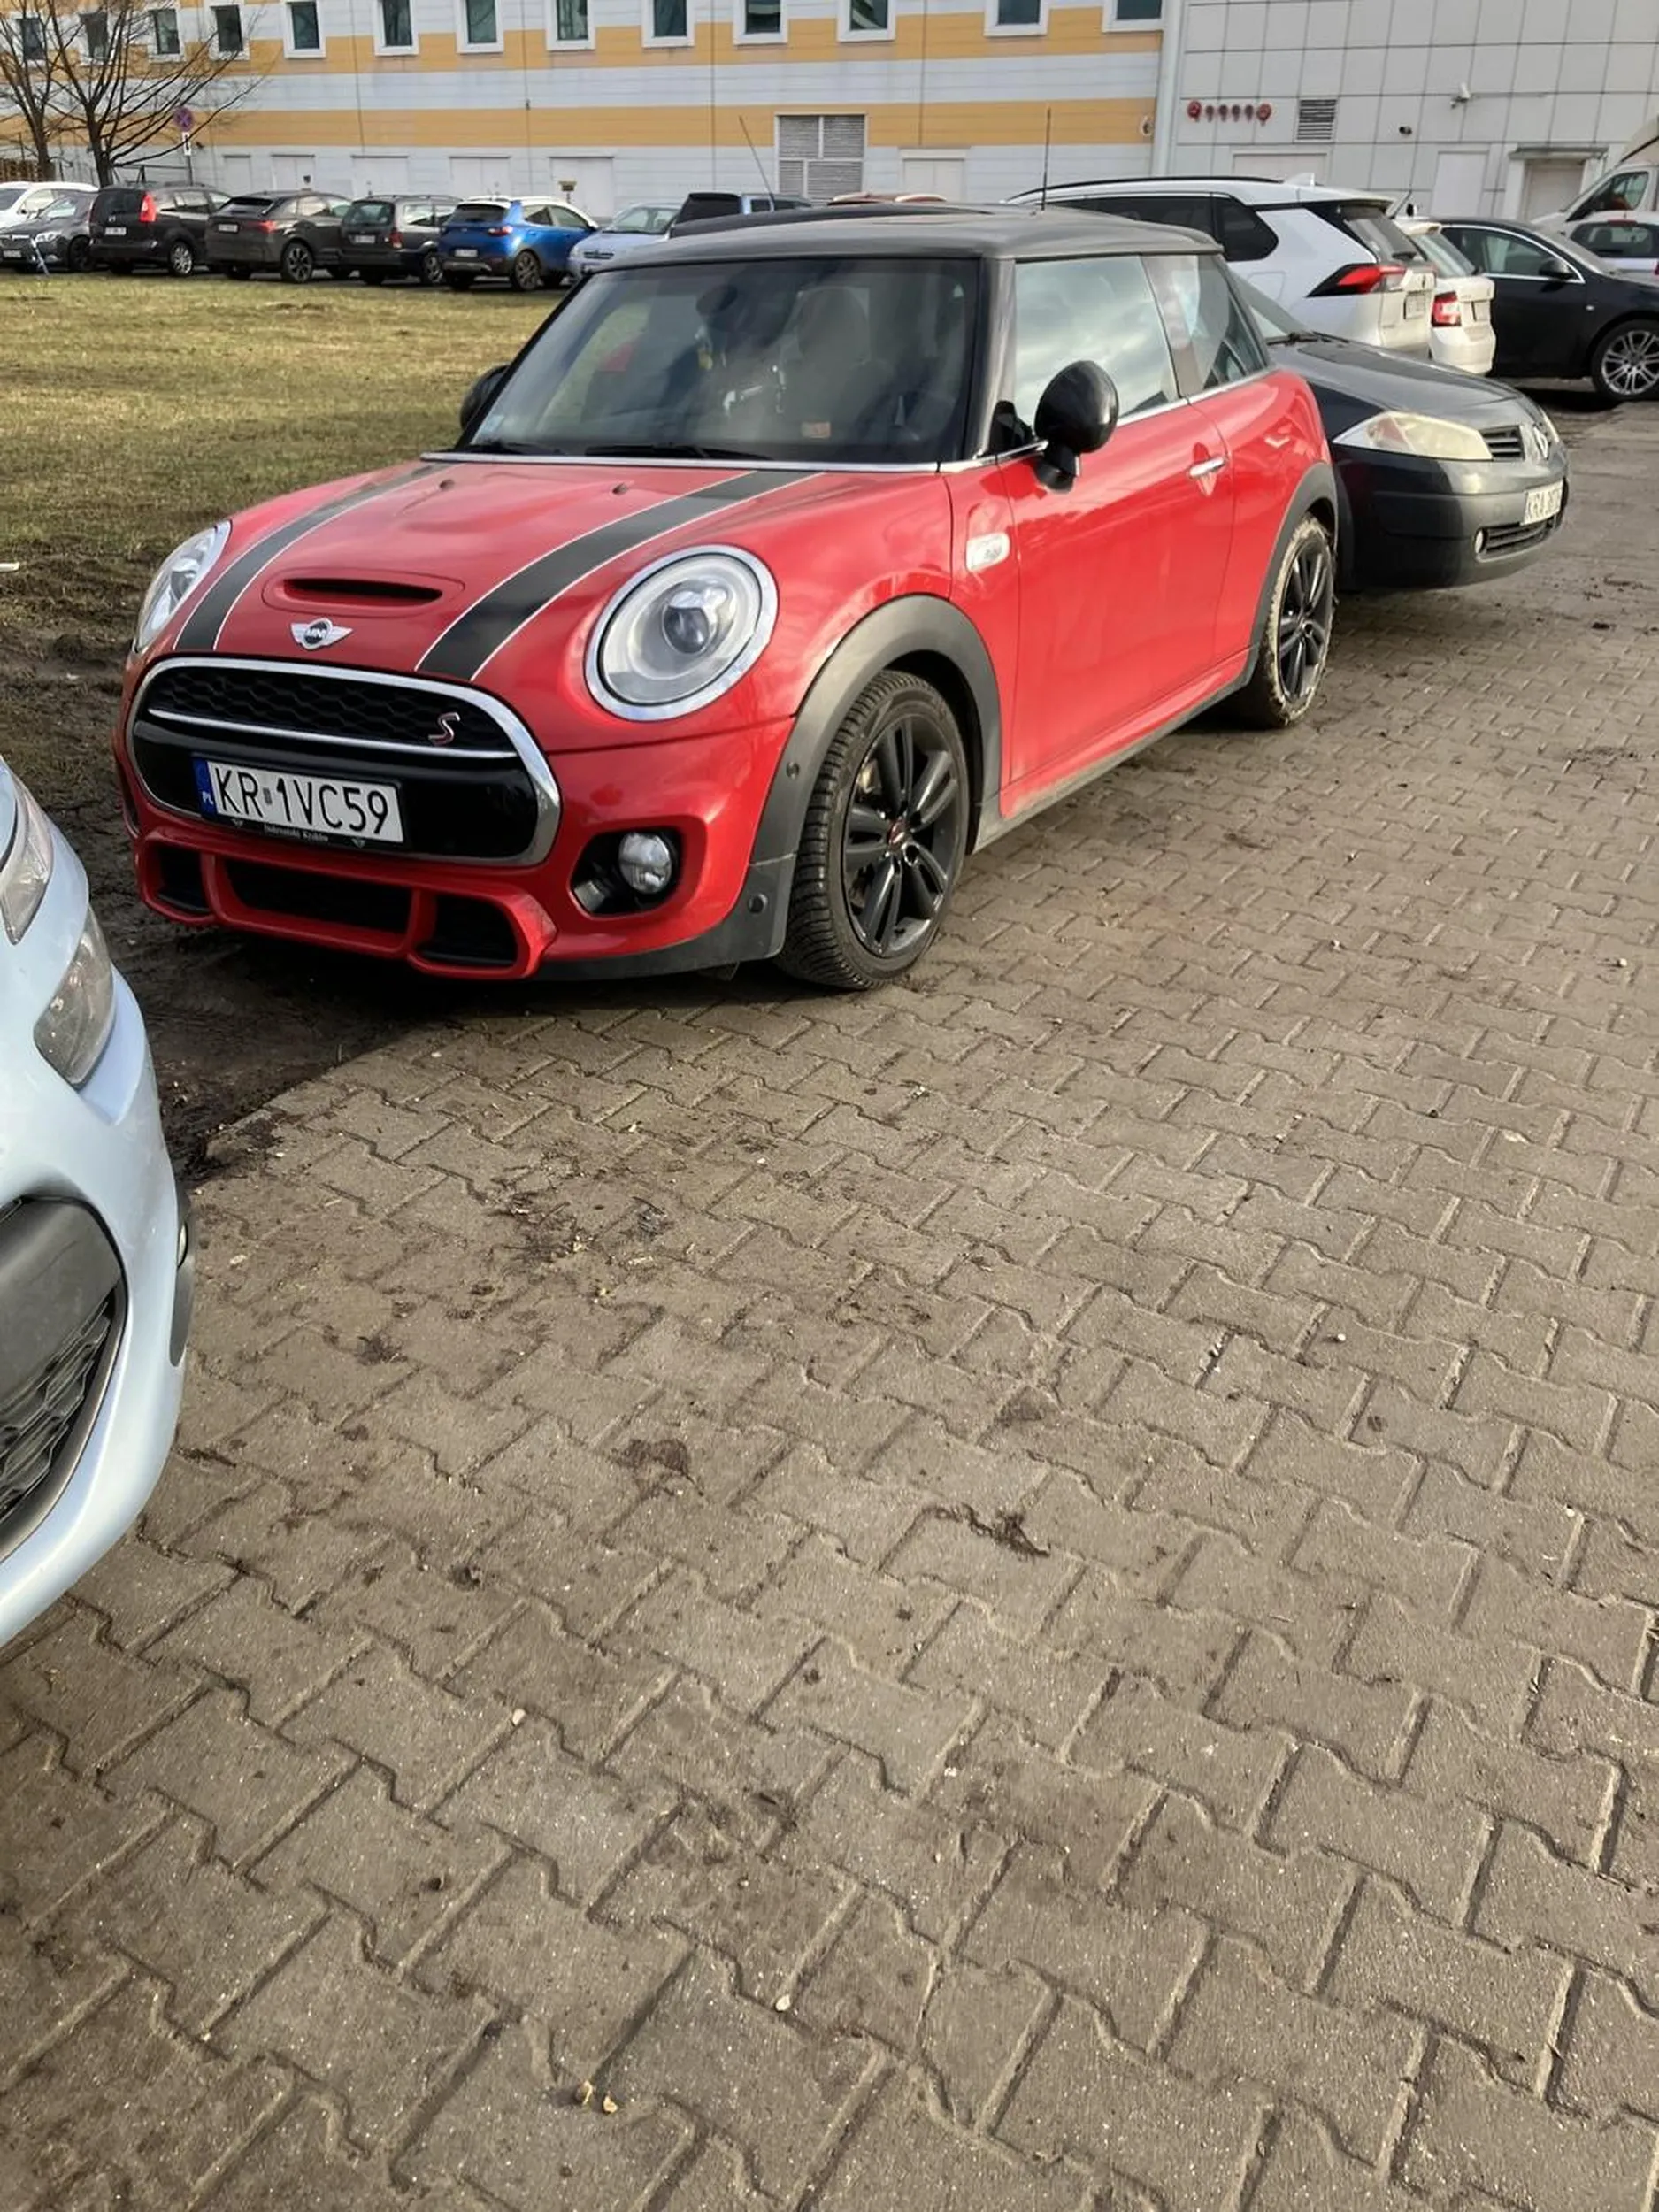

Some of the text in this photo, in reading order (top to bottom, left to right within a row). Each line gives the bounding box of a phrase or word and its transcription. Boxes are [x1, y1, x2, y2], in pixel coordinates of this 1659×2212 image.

[428, 711, 460, 746] S
[202, 790, 214, 805] PL
[215, 767, 389, 835] KR 1VC59
